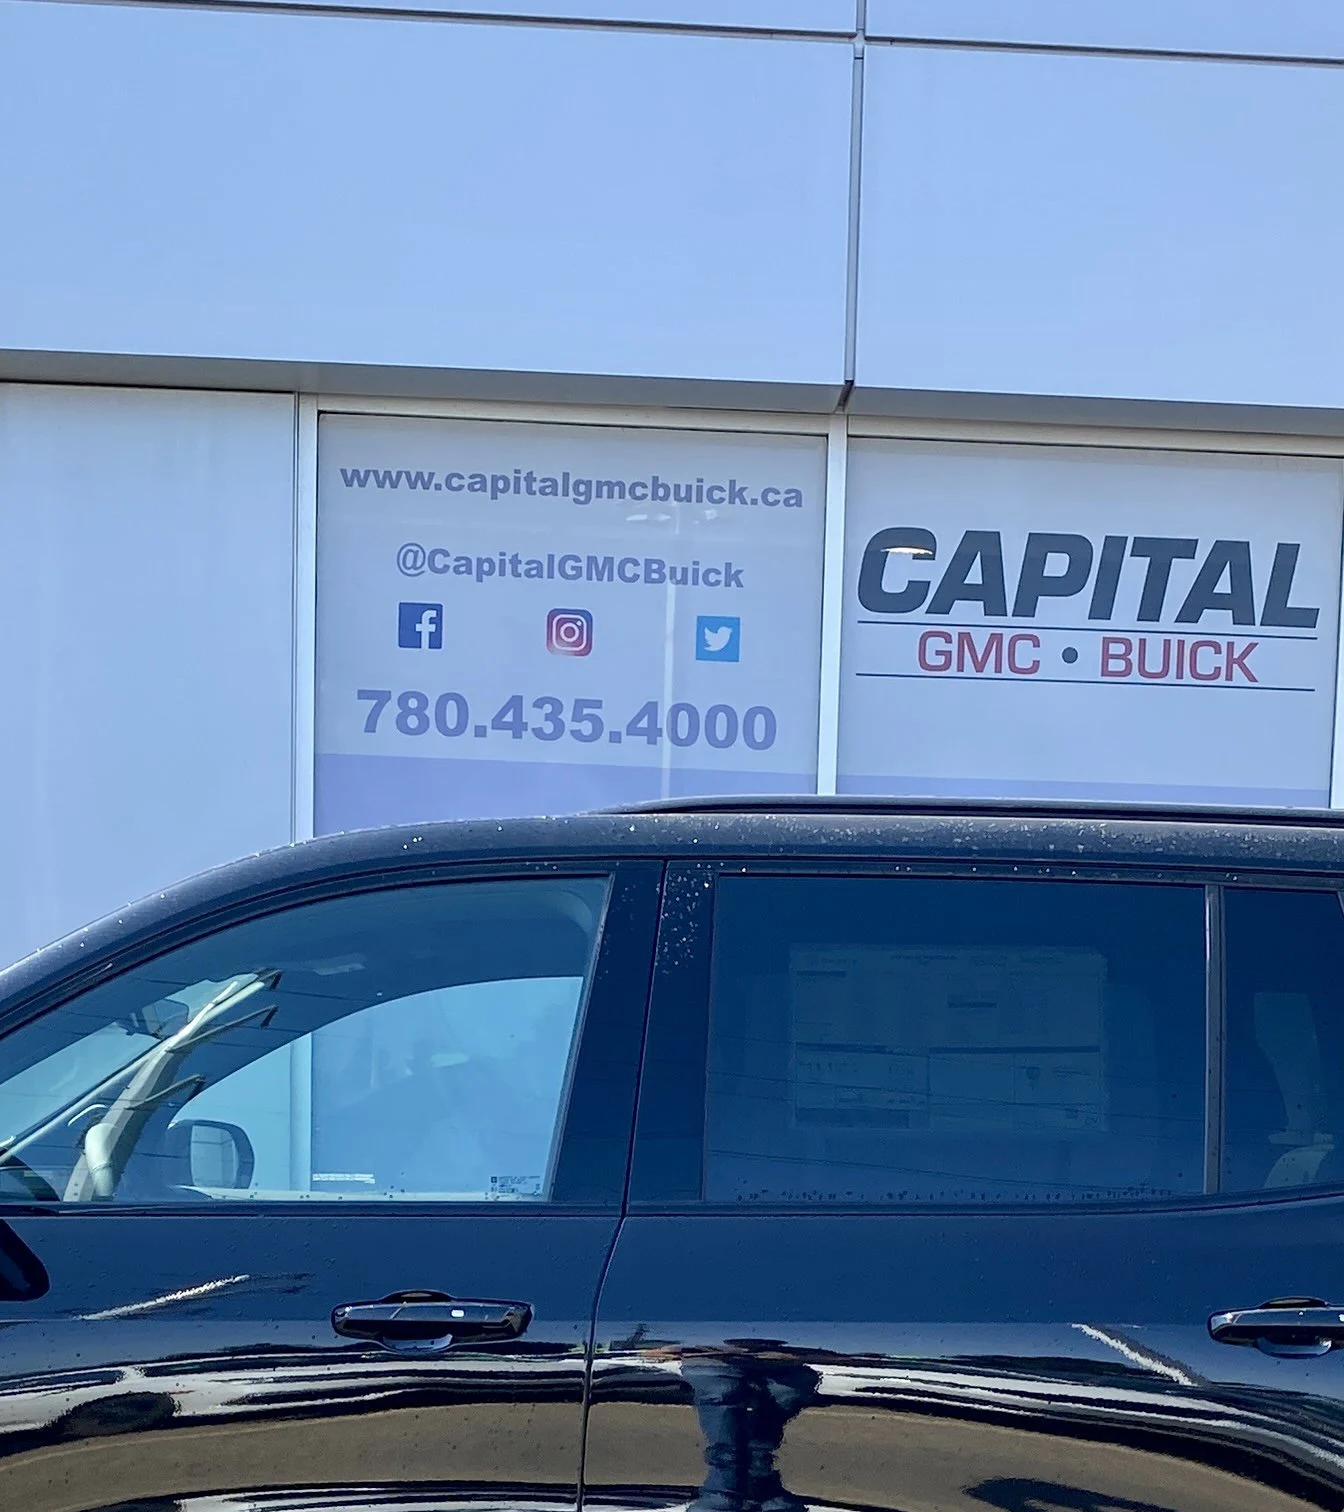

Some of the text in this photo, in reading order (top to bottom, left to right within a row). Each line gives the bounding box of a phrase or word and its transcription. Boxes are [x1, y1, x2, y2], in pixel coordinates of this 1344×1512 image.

[339, 467, 803, 508] www.capitalgmcbuick.ca
[396, 542, 745, 588] @CapitalGMCBuick
[856, 526, 1321, 629] CAPITAL
[917, 630, 1259, 683] GMC BUICK
[356, 688, 778, 751] 780.435.4000
